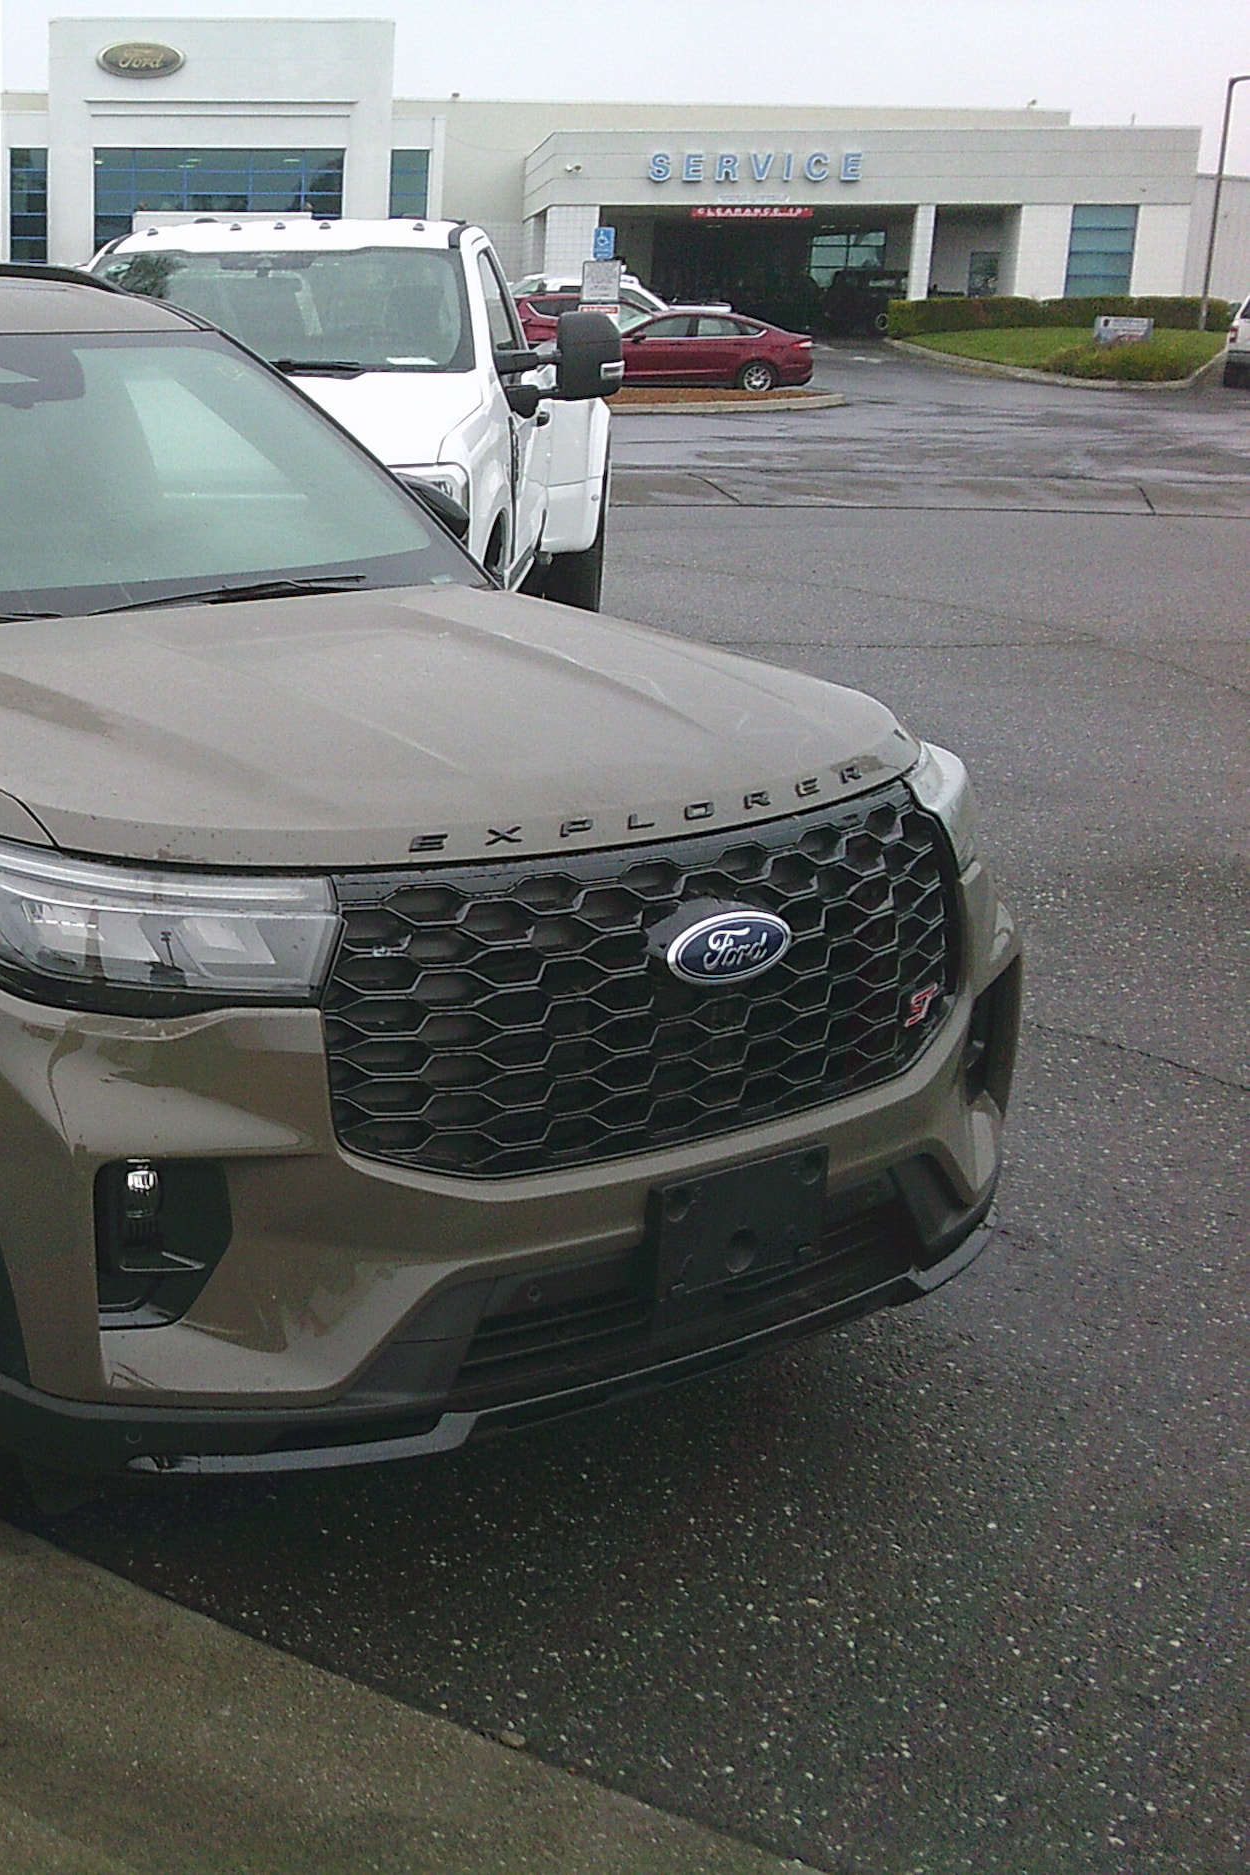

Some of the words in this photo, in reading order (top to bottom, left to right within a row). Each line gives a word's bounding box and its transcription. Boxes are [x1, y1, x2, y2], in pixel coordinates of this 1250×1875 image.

[119, 48, 164, 68] Ford
[649, 151, 863, 182] SERVICE
[696, 207, 781, 218] CLEARANCE
[408, 765, 863, 854] EXPLORER
[703, 926, 768, 971] Ford
[904, 982, 939, 1028] ST
